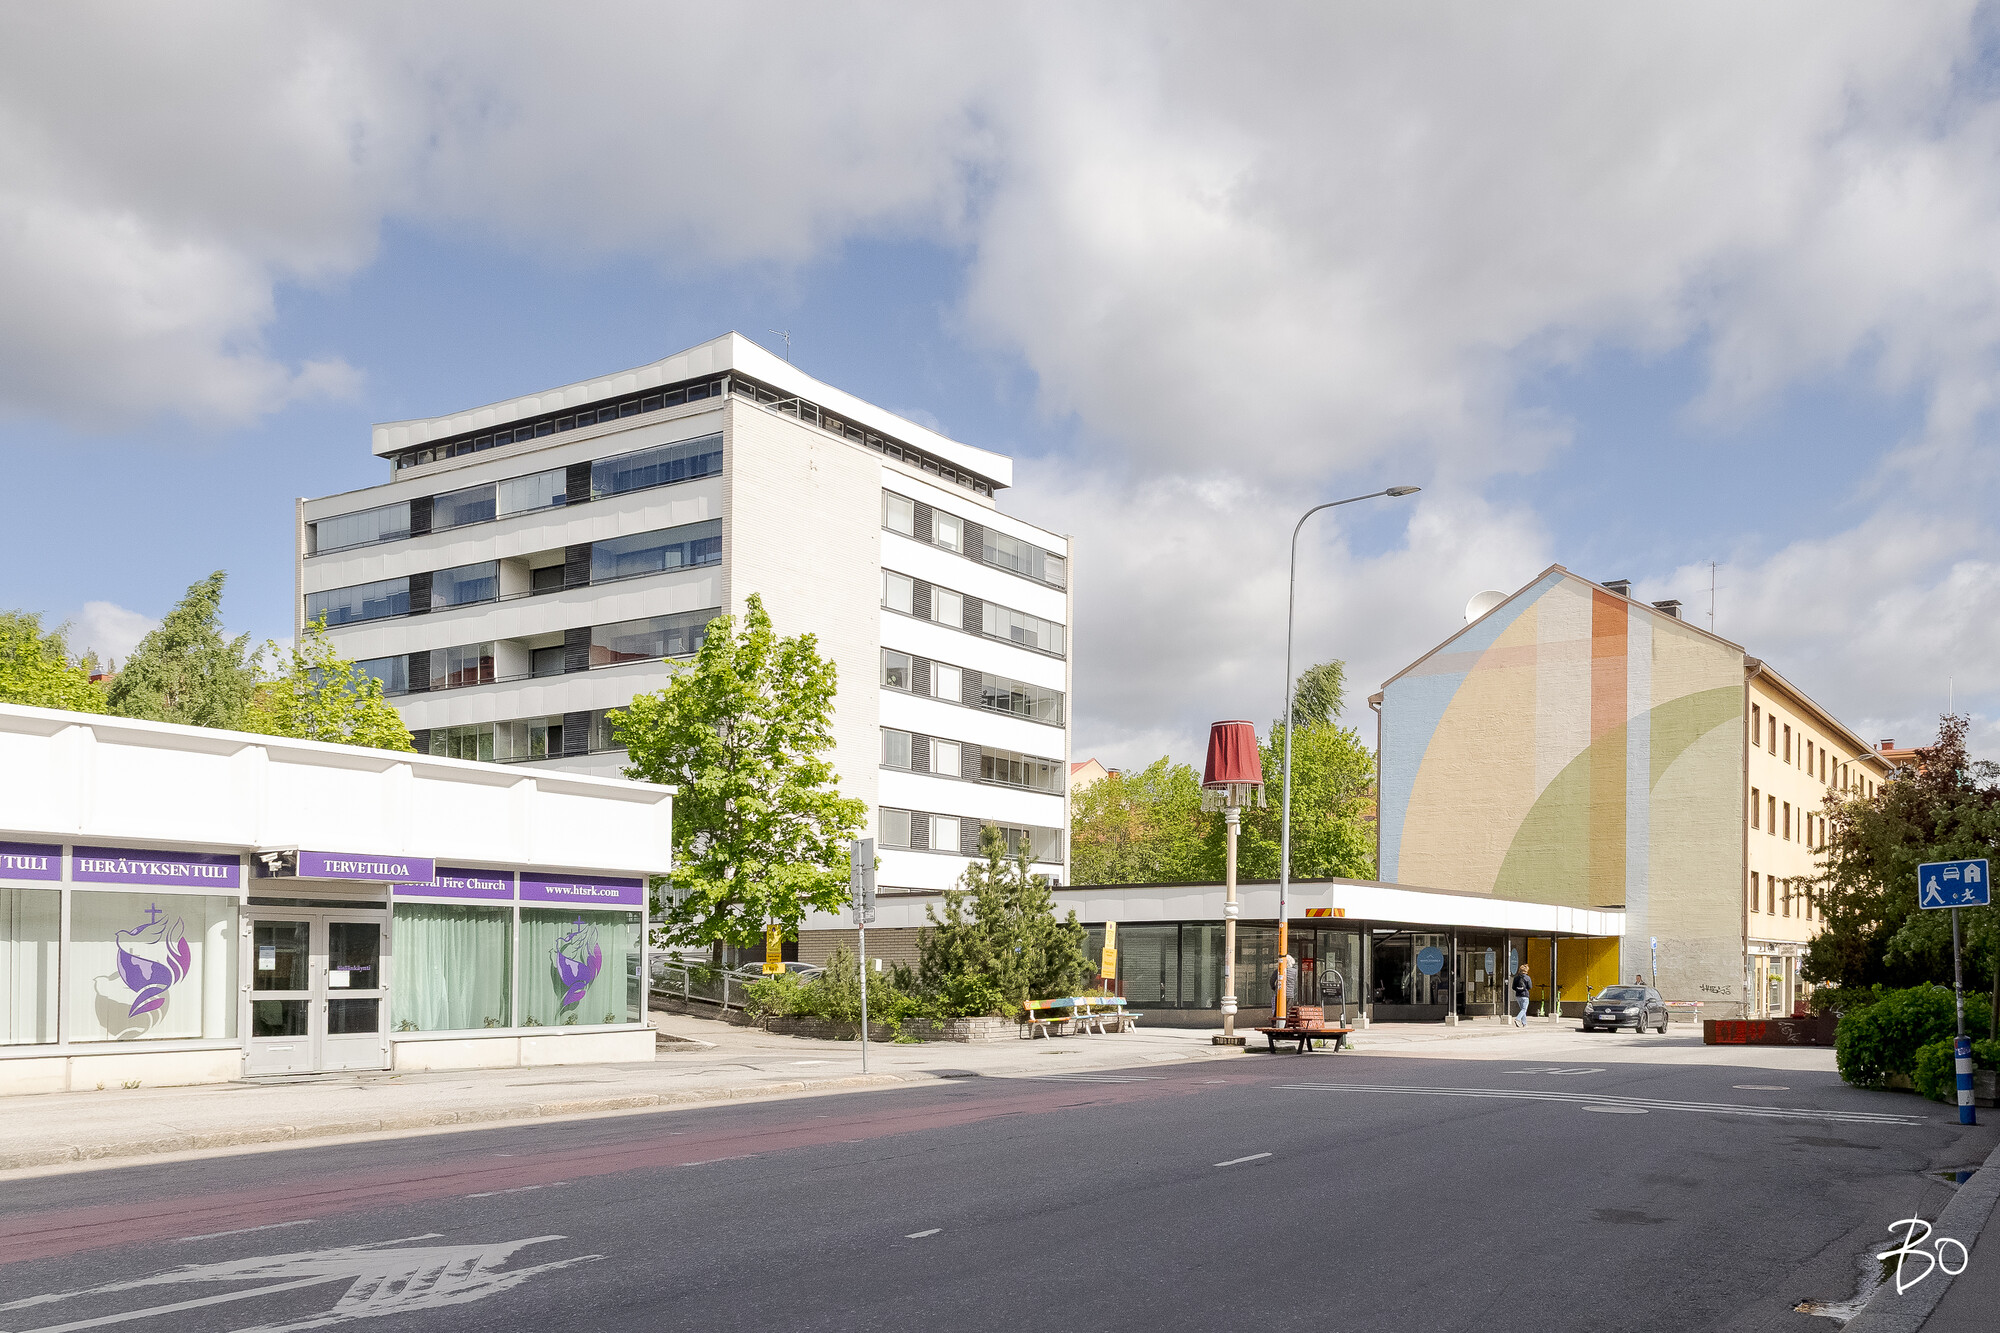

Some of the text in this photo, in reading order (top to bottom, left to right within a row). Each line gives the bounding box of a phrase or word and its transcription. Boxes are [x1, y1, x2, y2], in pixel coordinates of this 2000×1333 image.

[80, 858, 228, 879] HERÄTYKSEN TULI
[323, 859, 410, 876] TERVETULOA
[442, 877, 465, 889] Fire
[466, 878, 506, 891] Church
[545, 884, 620, 897] www.htsrk.com
